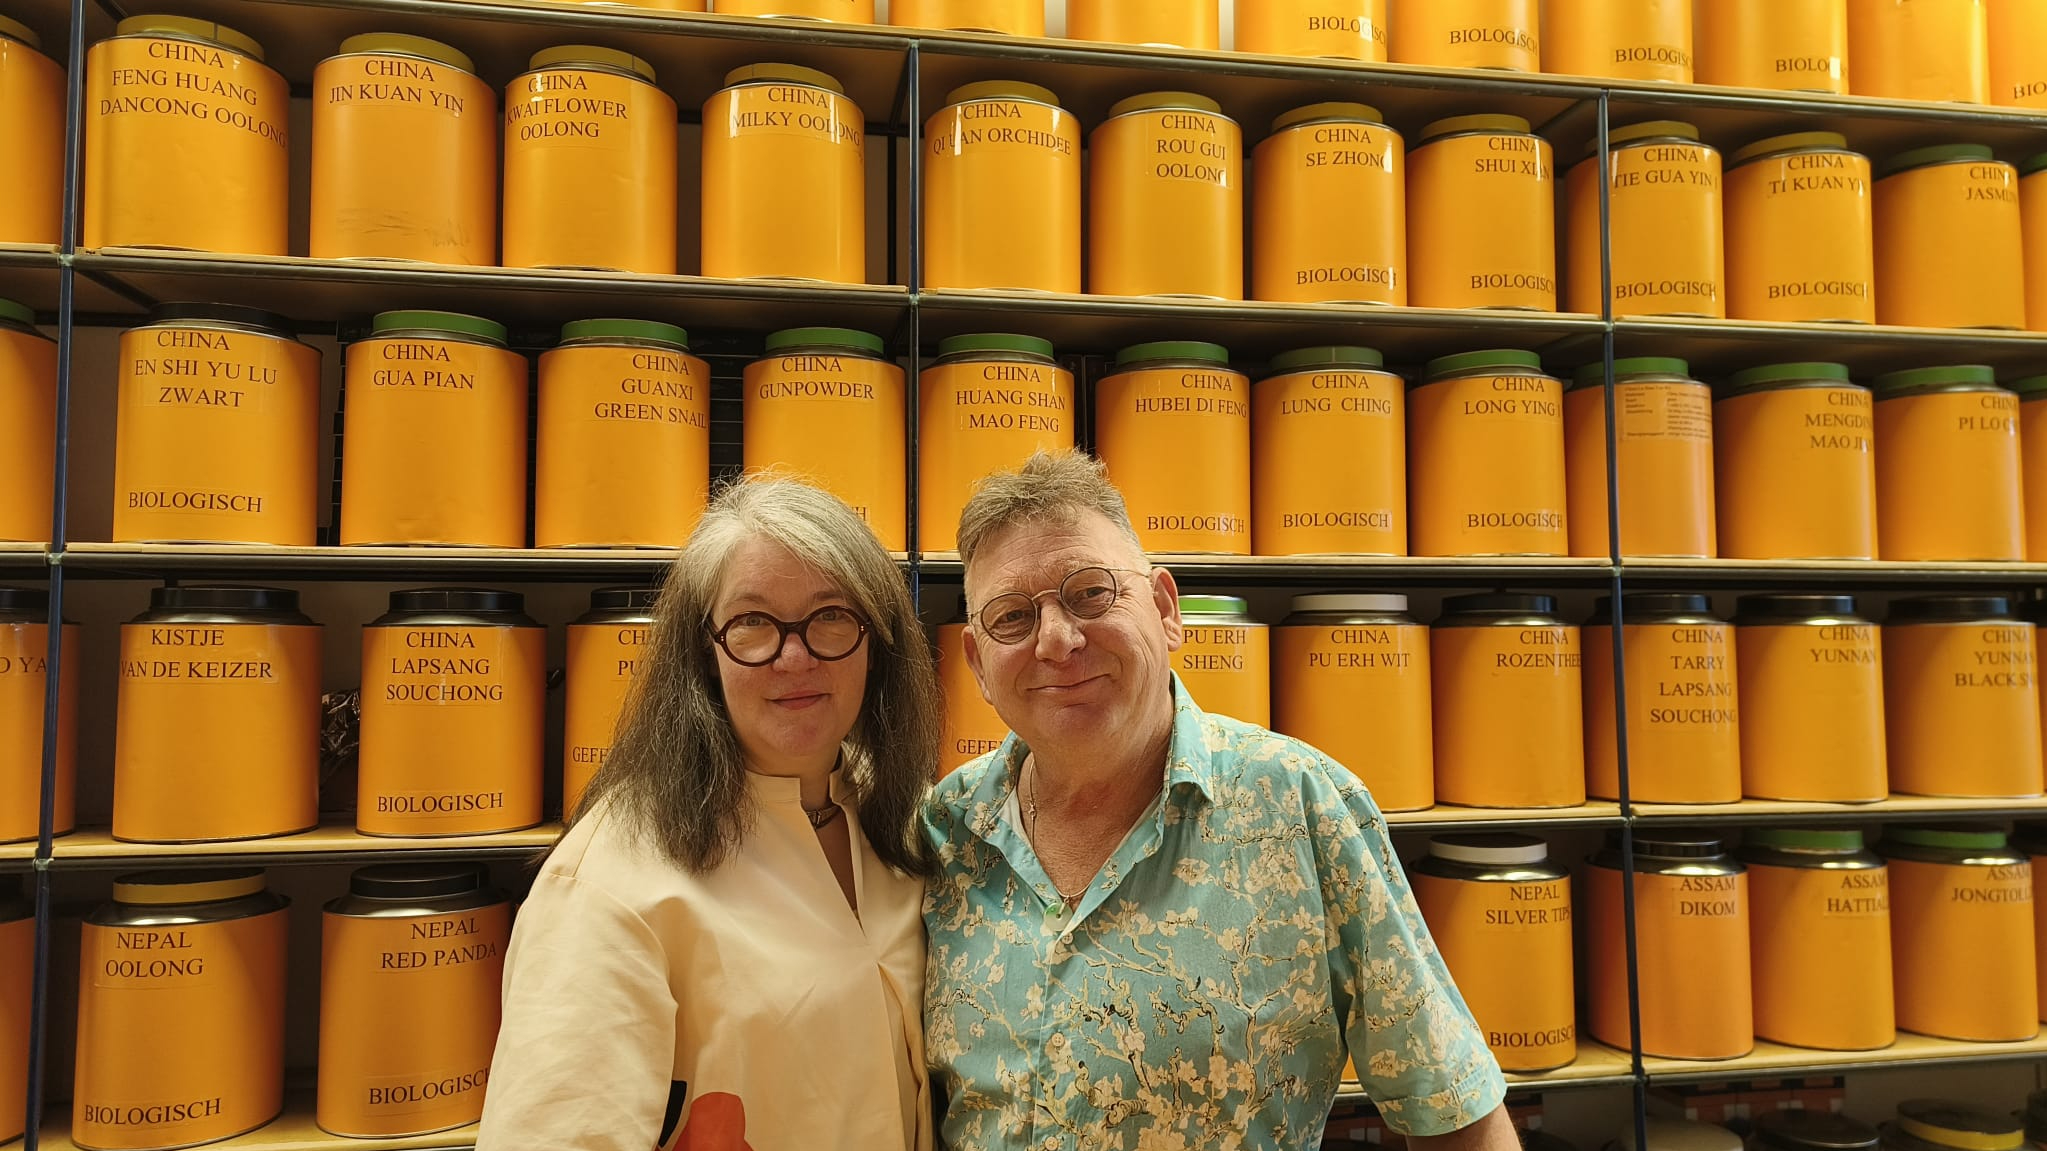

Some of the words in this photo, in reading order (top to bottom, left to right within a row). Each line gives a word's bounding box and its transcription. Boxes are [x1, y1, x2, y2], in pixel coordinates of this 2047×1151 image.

[148, 42, 224, 68] CHINA
[365, 60, 435, 83] CHINA
[112, 69, 167, 86] FENG
[175, 75, 258, 106] HUANG
[329, 86, 355, 102] JIN
[359, 83, 422, 102] KUAN
[429, 91, 464, 114] YIN
[768, 88, 828, 108] CHINA
[545, 98, 627, 119] FLOWER
[964, 104, 1022, 119] CHINA
[100, 100, 208, 119] DANCONG
[214, 107, 286, 148] OOLONG
[732, 112, 792, 127] MILKY
[1162, 115, 1216, 133] CHINA
[521, 121, 599, 140] OOLONG
[1315, 129, 1371, 143] CHINA
[934, 139, 945, 154] QI
[988, 128, 1071, 155] ORCHIDEE
[1157, 139, 1195, 153] ROU
[1200, 142, 1225, 160] GUI
[1306, 152, 1327, 166] SE
[1644, 149, 1698, 162] CHINA
[1788, 155, 1844, 170] CHINA
[1475, 159, 1515, 172] SHUI
[1612, 172, 1640, 188] TIE
[1646, 170, 1684, 183] GUA
[1690, 171, 1712, 186] YIN
[1769, 180, 1786, 194] TI
[1794, 176, 1843, 190] KUAN
[1615, 281, 1716, 299] BIOLOGISCH
[157, 331, 230, 352] CHINA
[383, 344, 451, 363] CHINA
[135, 359, 156, 376] EN
[162, 359, 198, 376] SHI
[208, 361, 240, 380] YU
[249, 366, 277, 385] LU
[632, 354, 690, 376] CHINA
[782, 357, 843, 372] CHINA
[373, 370, 416, 387] GUA
[423, 371, 474, 390] PIAN
[983, 366, 1041, 383] CHINA
[1181, 374, 1233, 392] CHINA
[1312, 375, 1369, 390] CHINA
[621, 378, 693, 401] GUANXI
[760, 382, 874, 399] GUNPOWDER
[1493, 378, 1544, 392] CHINA
[159, 387, 245, 408] ZWART
[956, 390, 1023, 406] HUANG
[1028, 392, 1065, 410] SHAN
[1136, 398, 1191, 413] HUBEI
[1197, 398, 1214, 412] DI
[1218, 400, 1247, 417] FENG
[1282, 398, 1331, 415] LUNG
[1341, 398, 1392, 415] CHING
[1464, 400, 1515, 414] LONG
[1522, 400, 1554, 416] YING
[595, 403, 663, 420] GREEN
[669, 407, 706, 428] SNAIL
[969, 414, 1014, 429] MAO
[1019, 414, 1060, 432] FENG
[1959, 417, 1974, 430] PI
[1981, 417, 2000, 430] LO
[1810, 435, 1850, 448] MAO
[128, 492, 262, 513] BIOLOGISCH
[1147, 516, 1244, 533] BIOLOGISCH
[1283, 513, 1390, 528] BIOLOGISCH
[1468, 513, 1562, 528] BIOLOGISCH
[151, 629, 224, 646] KISTJE
[406, 632, 475, 649] CHINA
[1184, 630, 1207, 643] PU
[1214, 630, 1245, 644] ERH
[1331, 629, 1390, 645] CHINA
[1520, 631, 1568, 644] CHINA
[1672, 629, 1723, 643] CHINA
[1819, 627, 1869, 640] CHINA
[392, 658, 490, 676] LAPSANG
[1184, 655, 1242, 669] SHENG
[1309, 653, 1331, 667] PU
[1337, 653, 1375, 667] ERH
[1381, 653, 1410, 667] WIT
[1671, 656, 1724, 669] TARRY
[121, 661, 148, 677] VAN
[153, 662, 180, 678] DE
[187, 661, 272, 679] KEIZER
[1955, 673, 2015, 687] BLACK
[386, 684, 503, 701] SOUCHONG
[1659, 682, 1731, 696] LAPSANG
[377, 793, 503, 813] BIOLOGISCH
[1510, 885, 1560, 900] NEPAL
[1680, 877, 1736, 892] ASSAM
[1486, 909, 1547, 924] SILVER
[1680, 901, 1736, 916] DIKOM
[411, 918, 480, 940] NEPAL
[116, 931, 192, 950] NEPAL
[381, 951, 426, 969] RED
[433, 942, 497, 967] PANDA
[105, 957, 204, 978] OOLONG
[84, 1097, 222, 1126] BIOLOGISCH
